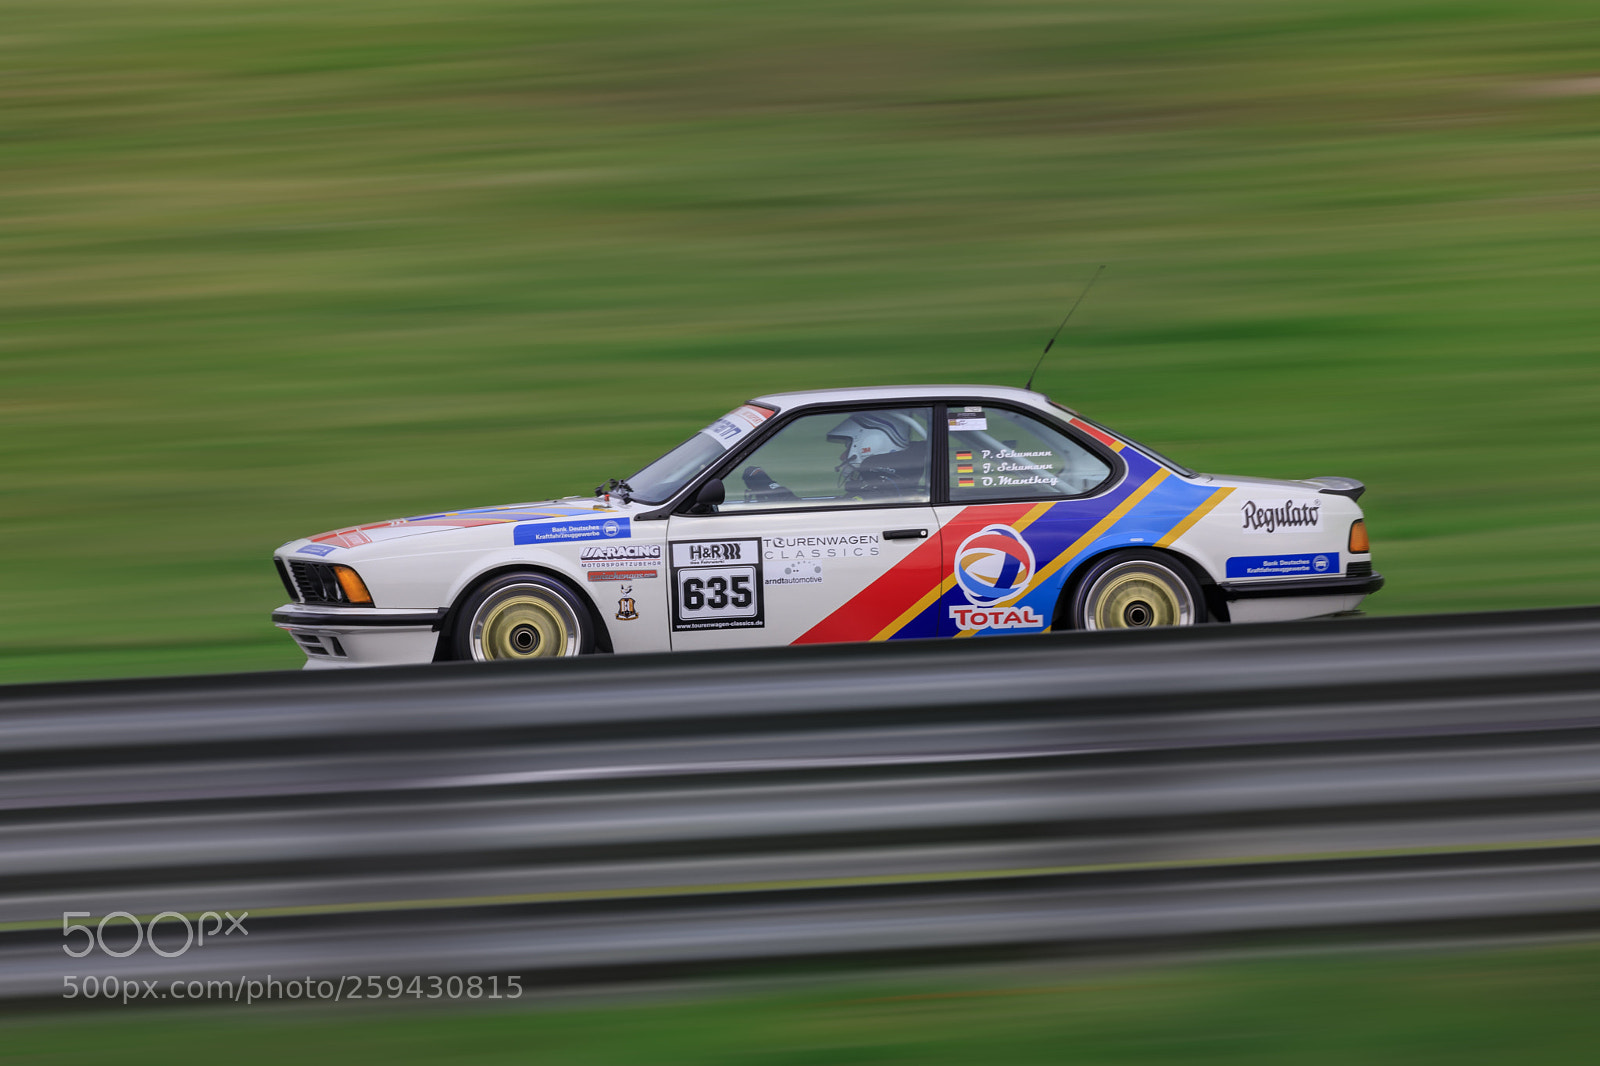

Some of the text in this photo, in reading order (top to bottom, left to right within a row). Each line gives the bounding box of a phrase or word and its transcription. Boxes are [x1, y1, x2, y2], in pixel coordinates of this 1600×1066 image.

[981, 449, 1053, 459] P. Schumann
[997, 462, 1054, 472] Schumann
[998, 476, 1060, 486] Manthey
[535, 531, 600, 540] Kraftfahrzeuggewerbe
[763, 535, 879, 549] TOURENWAGEN
[764, 548, 879, 560] CLASSICS
[683, 575, 752, 611] 635
[953, 609, 1039, 626] TOTAL
[676, 620, 763, 629] www.tourenwagen-classics.de
